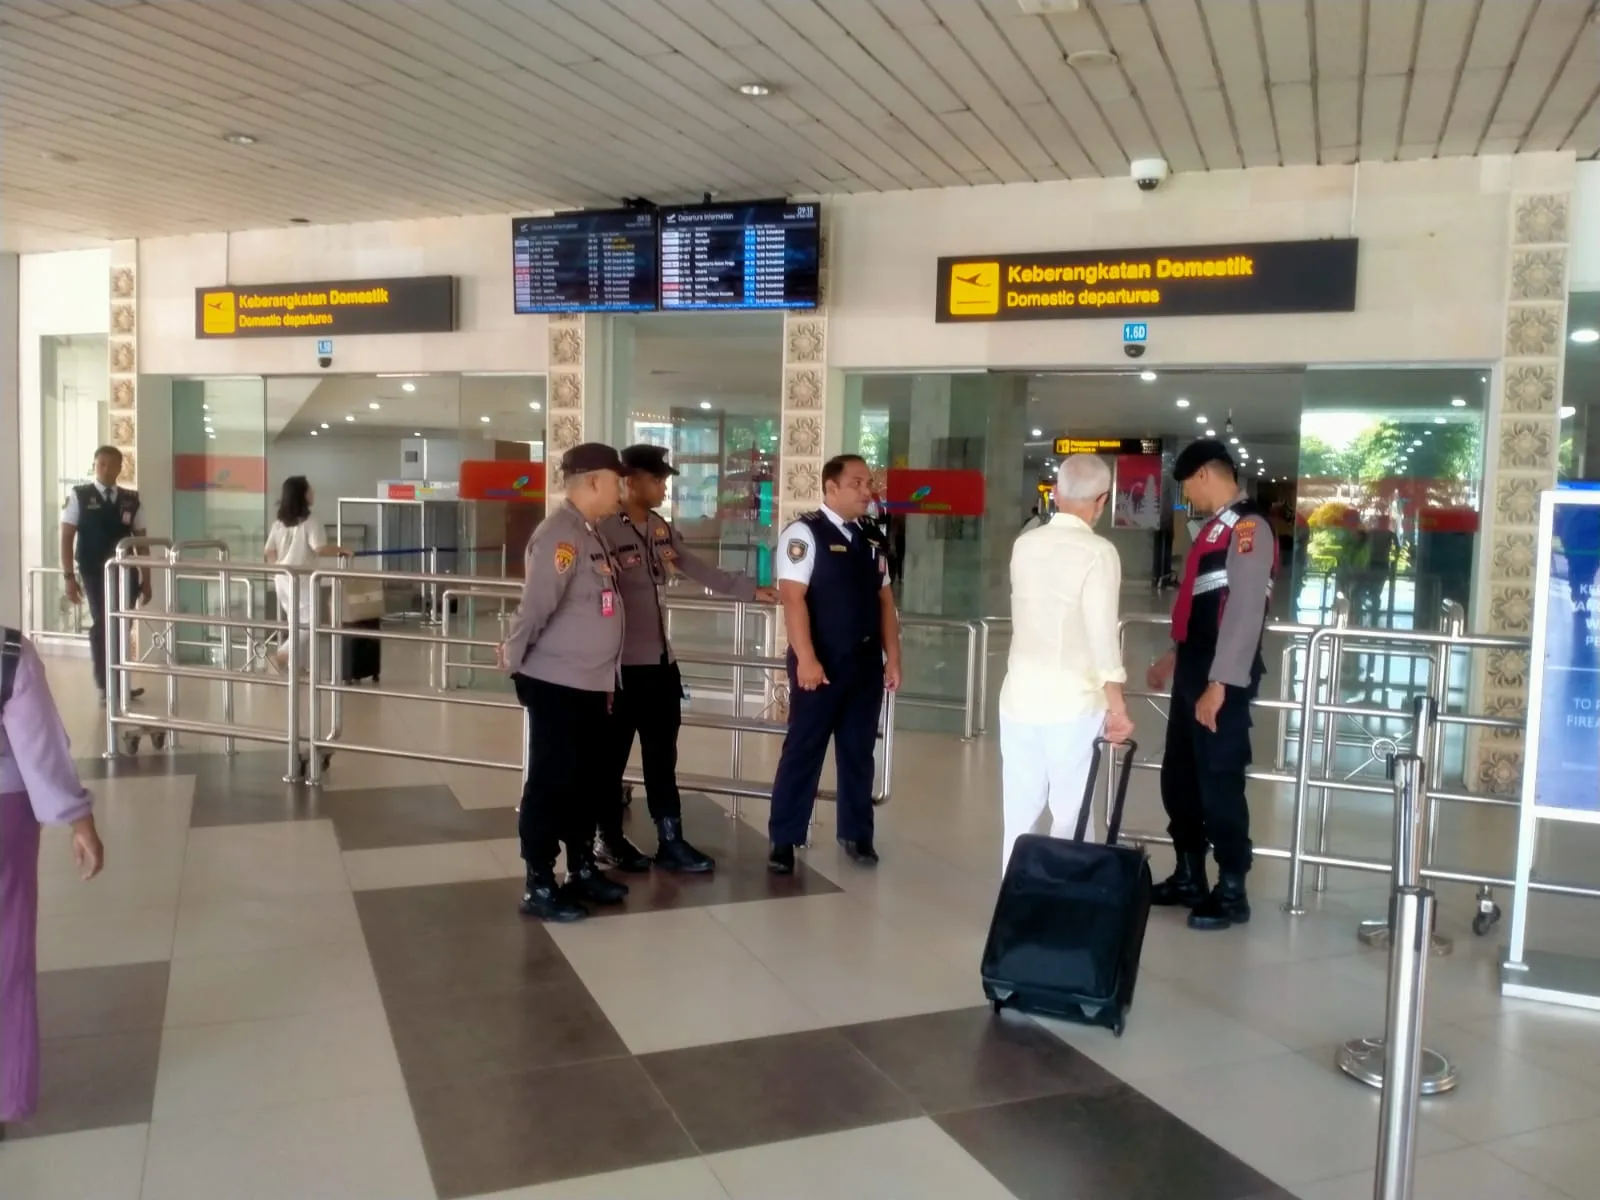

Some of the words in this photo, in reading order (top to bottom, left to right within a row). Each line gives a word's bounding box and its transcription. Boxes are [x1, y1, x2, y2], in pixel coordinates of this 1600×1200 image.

[1008, 262, 1151, 286] Keberangkatan
[1156, 256, 1253, 280] Domestik
[239, 291, 326, 310] Keberangkatan
[330, 287, 389, 305] Domestik
[1007, 290, 1074, 307] Domestic
[1078, 288, 1160, 308] departures
[239, 314, 281, 328] Domestic
[283, 313, 333, 328] departures
